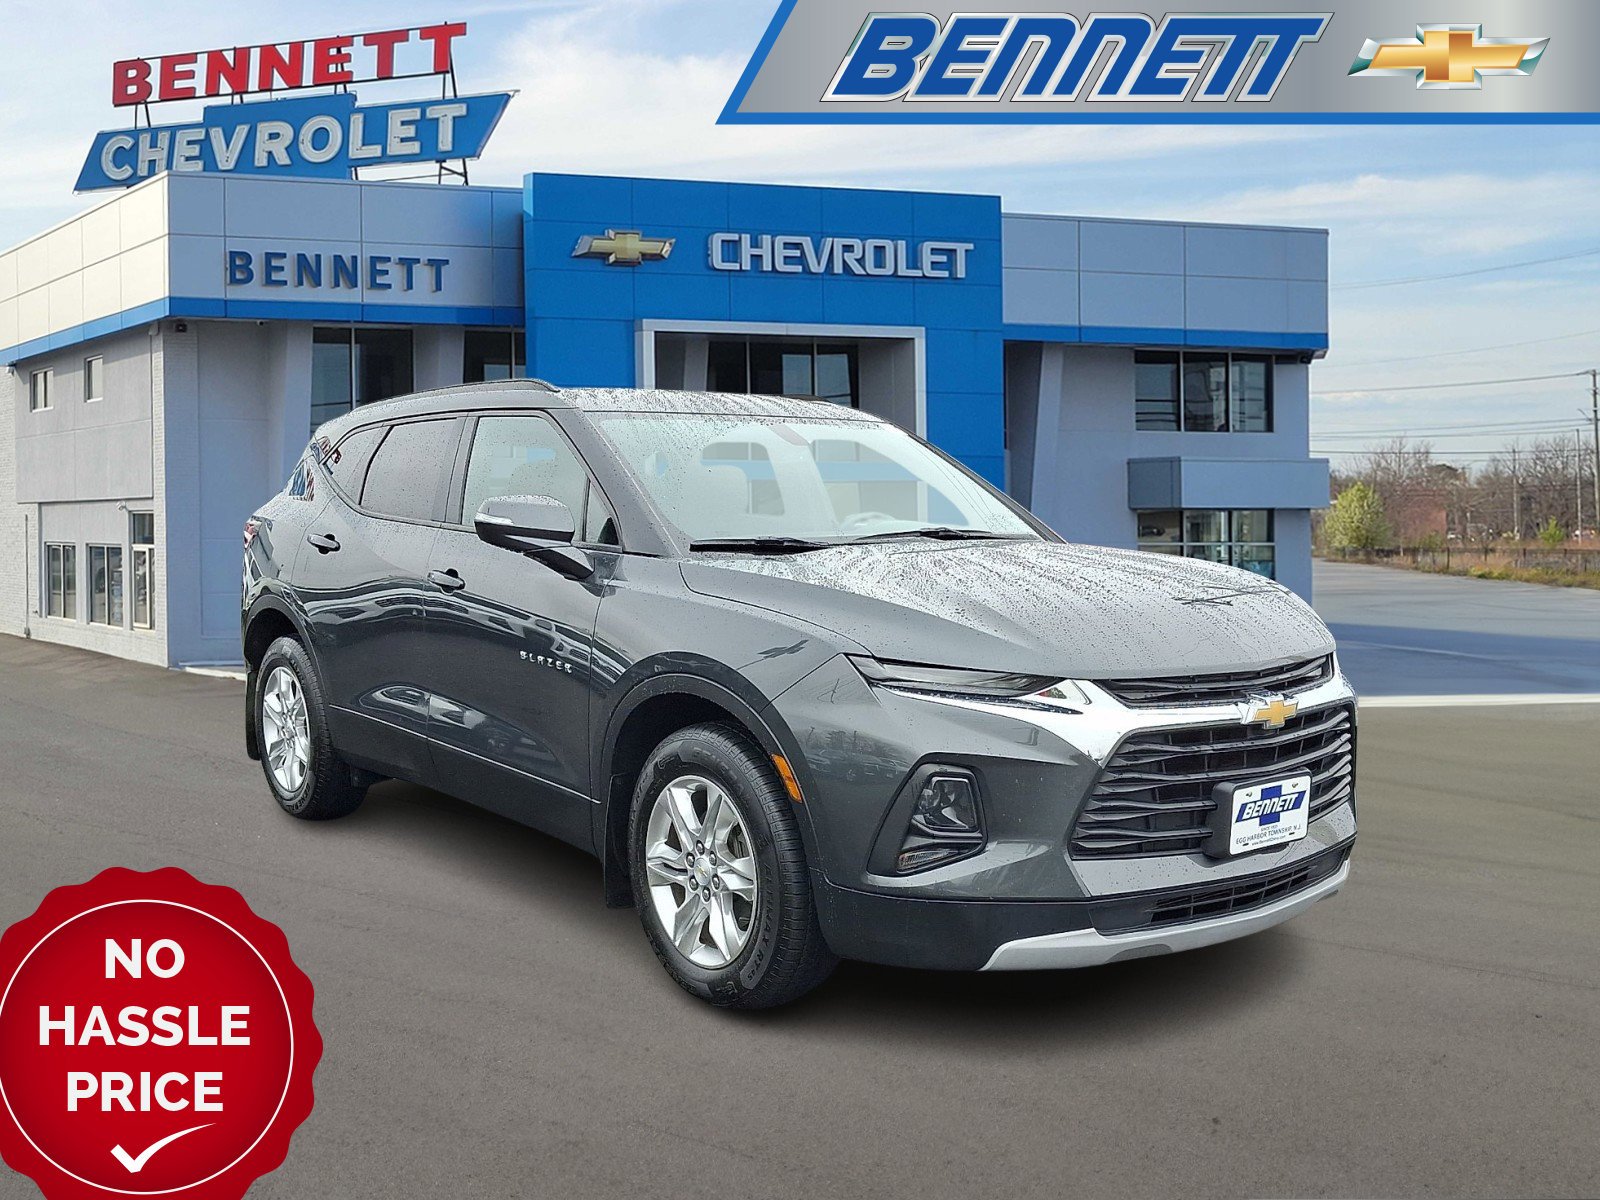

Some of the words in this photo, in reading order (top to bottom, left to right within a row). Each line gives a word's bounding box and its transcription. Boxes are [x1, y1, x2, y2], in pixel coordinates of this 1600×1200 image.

[112, 22, 467, 107] BENNETT
[101, 103, 468, 181] CHEVROLET
[227, 249, 450, 293] BENNETT
[708, 232, 976, 280] CHEVROLET
[520, 650, 572, 674] BLAZER
[1242, 794, 1299, 820] BENNETT
[1235, 836, 1246, 845] EGG
[1246, 831, 1268, 842] HARBOR
